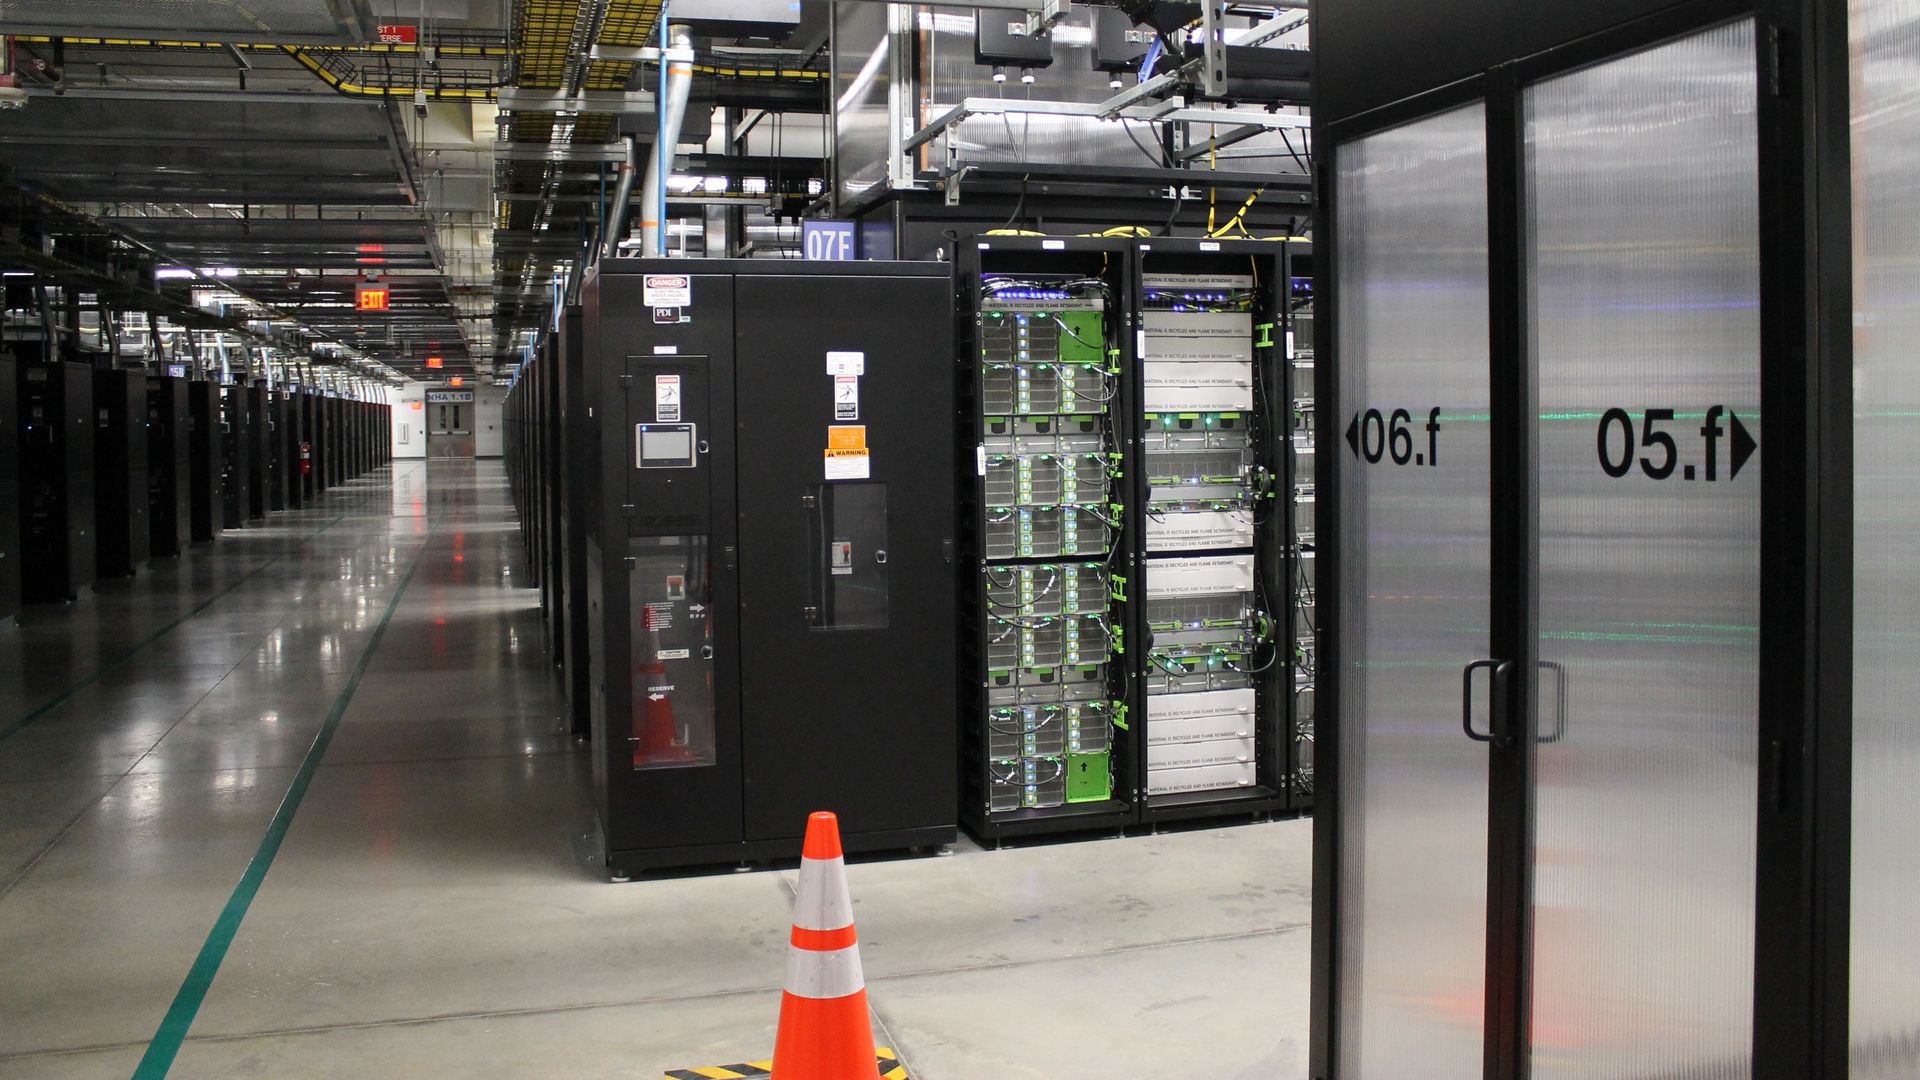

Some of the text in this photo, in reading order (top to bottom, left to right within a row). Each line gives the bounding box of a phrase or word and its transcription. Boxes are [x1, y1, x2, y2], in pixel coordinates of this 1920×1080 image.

[807, 230, 851, 260] 07F
[361, 291, 385, 308] EXIT
[656, 308, 672, 317] PDI
[427, 393, 448, 401] NHA
[1362, 406, 1441, 467] 06.f
[1597, 405, 1724, 482] 05.f
